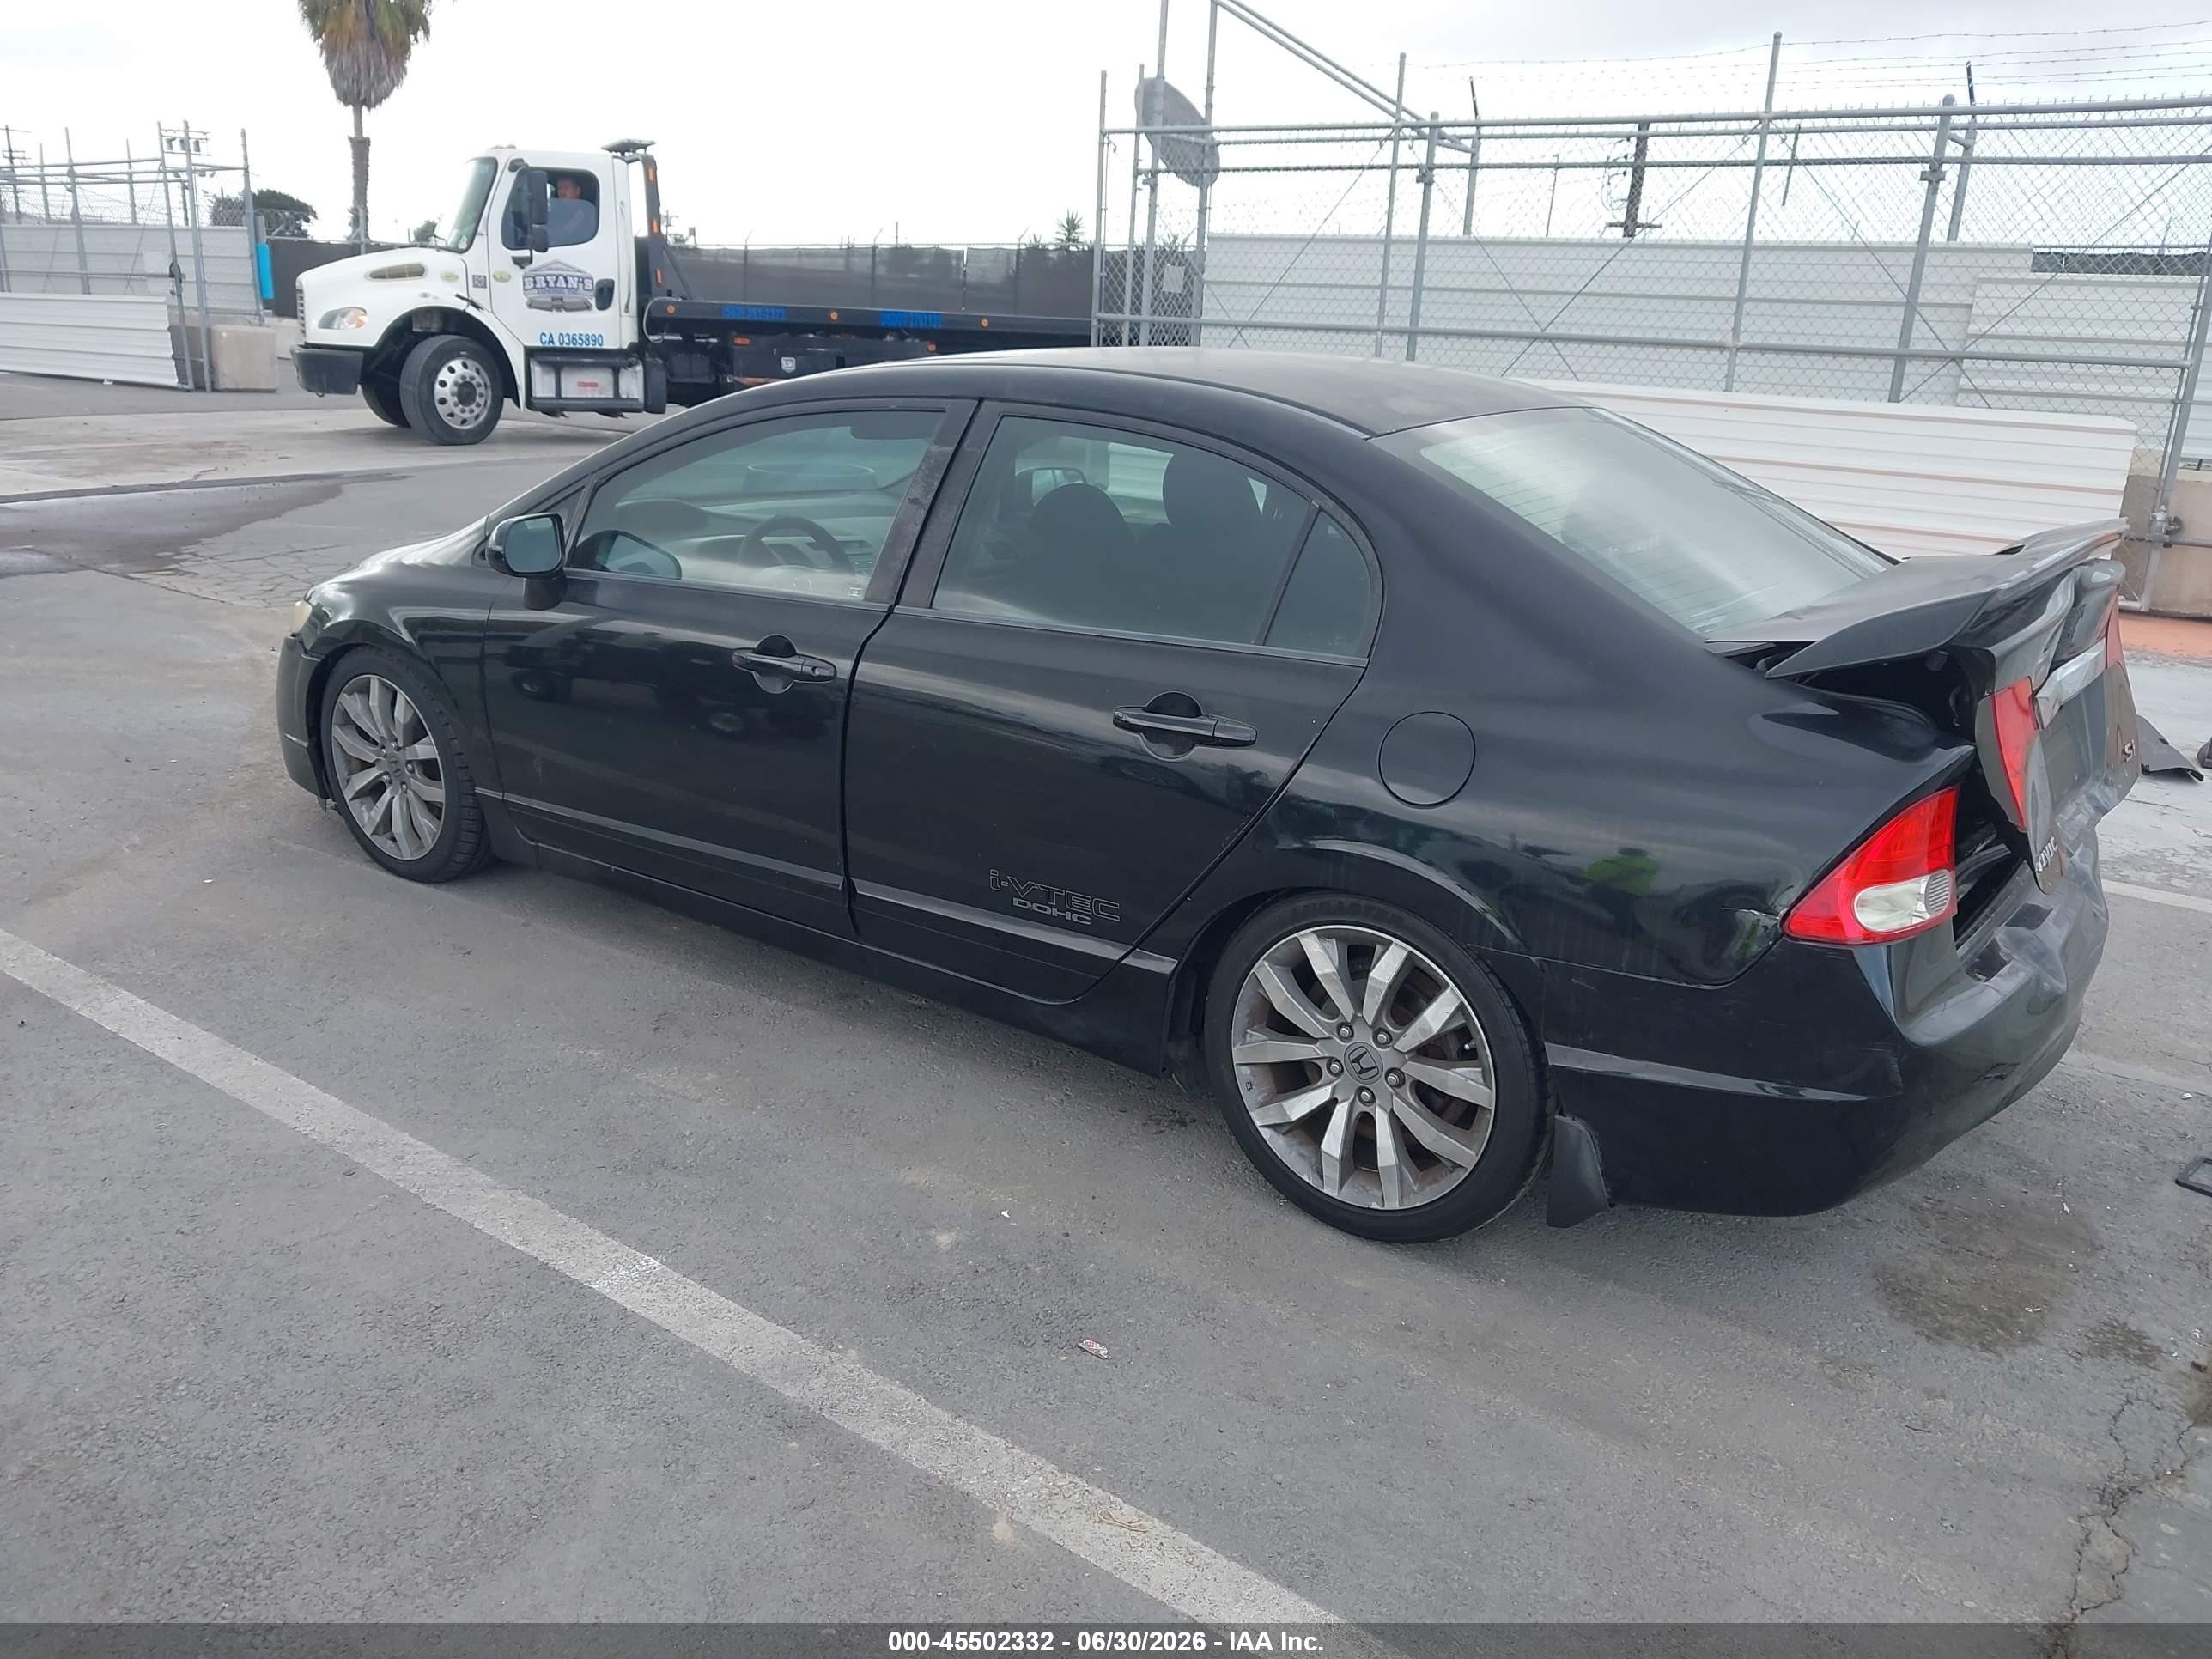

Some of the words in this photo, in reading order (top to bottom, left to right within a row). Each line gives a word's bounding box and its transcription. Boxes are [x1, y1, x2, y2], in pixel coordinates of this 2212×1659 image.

[523, 275, 593, 290] BRYAN'S
[539, 332, 555, 345] CA
[558, 332, 604, 347] 0365890
[989, 869, 1121, 922] i-VTEC
[1012, 897, 1091, 926] DOHC
